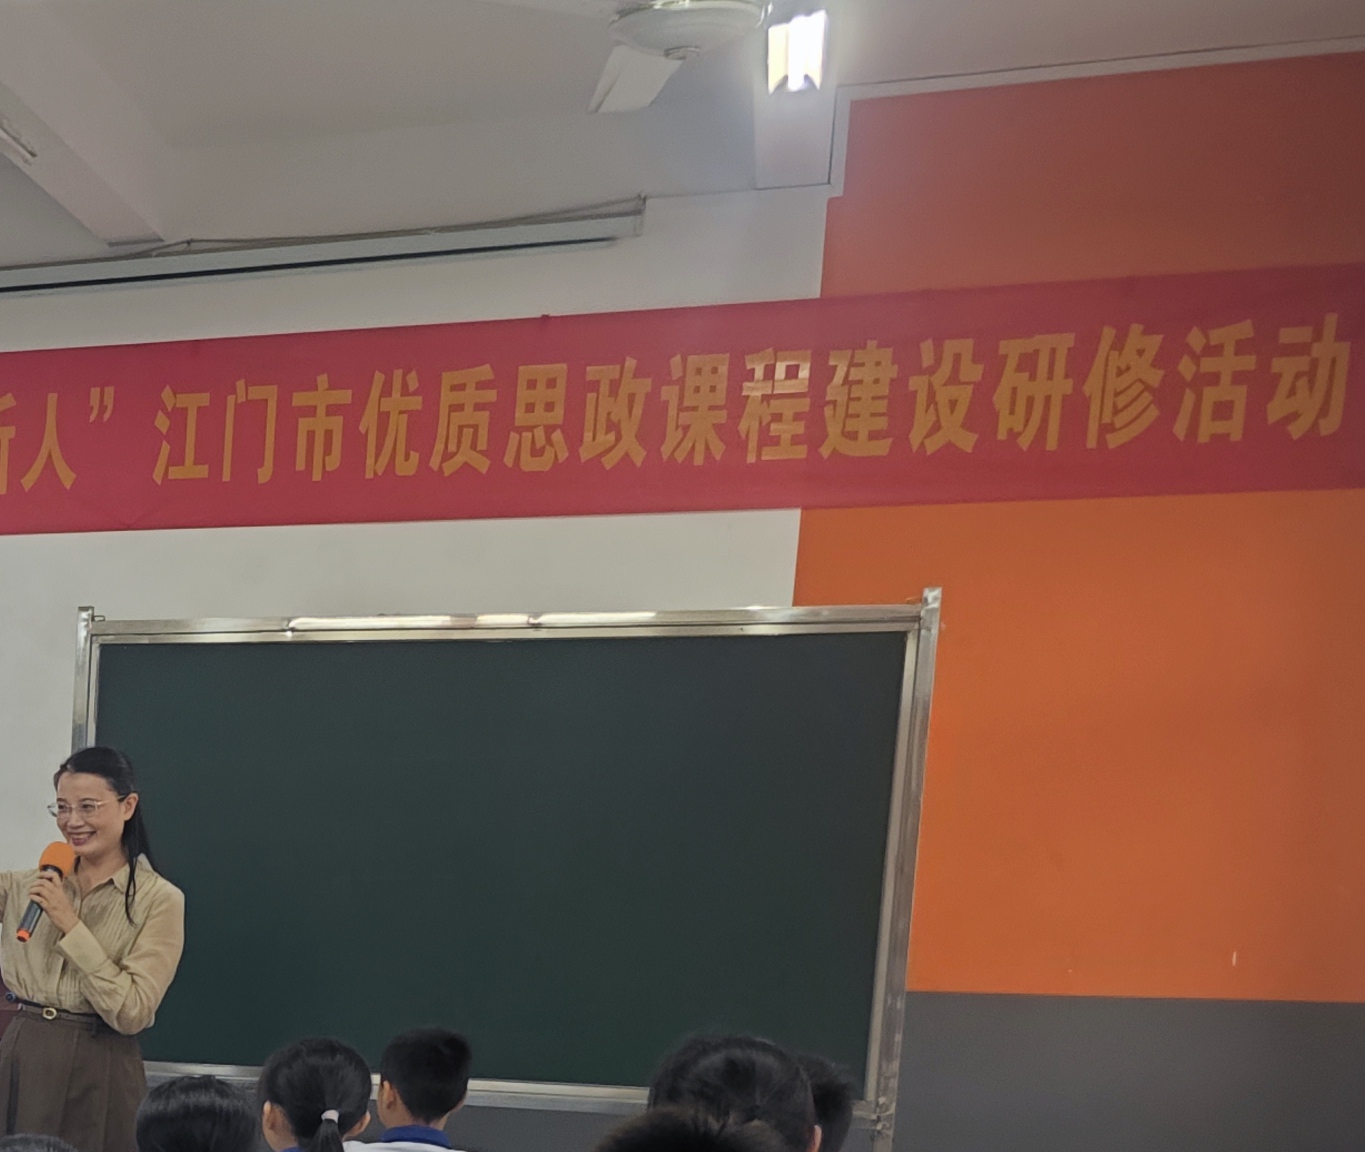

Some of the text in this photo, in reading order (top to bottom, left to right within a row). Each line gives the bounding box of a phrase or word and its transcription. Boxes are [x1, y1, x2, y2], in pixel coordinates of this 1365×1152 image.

[152, 312, 1352, 486] 江门市优质思政课程建设研修活动
